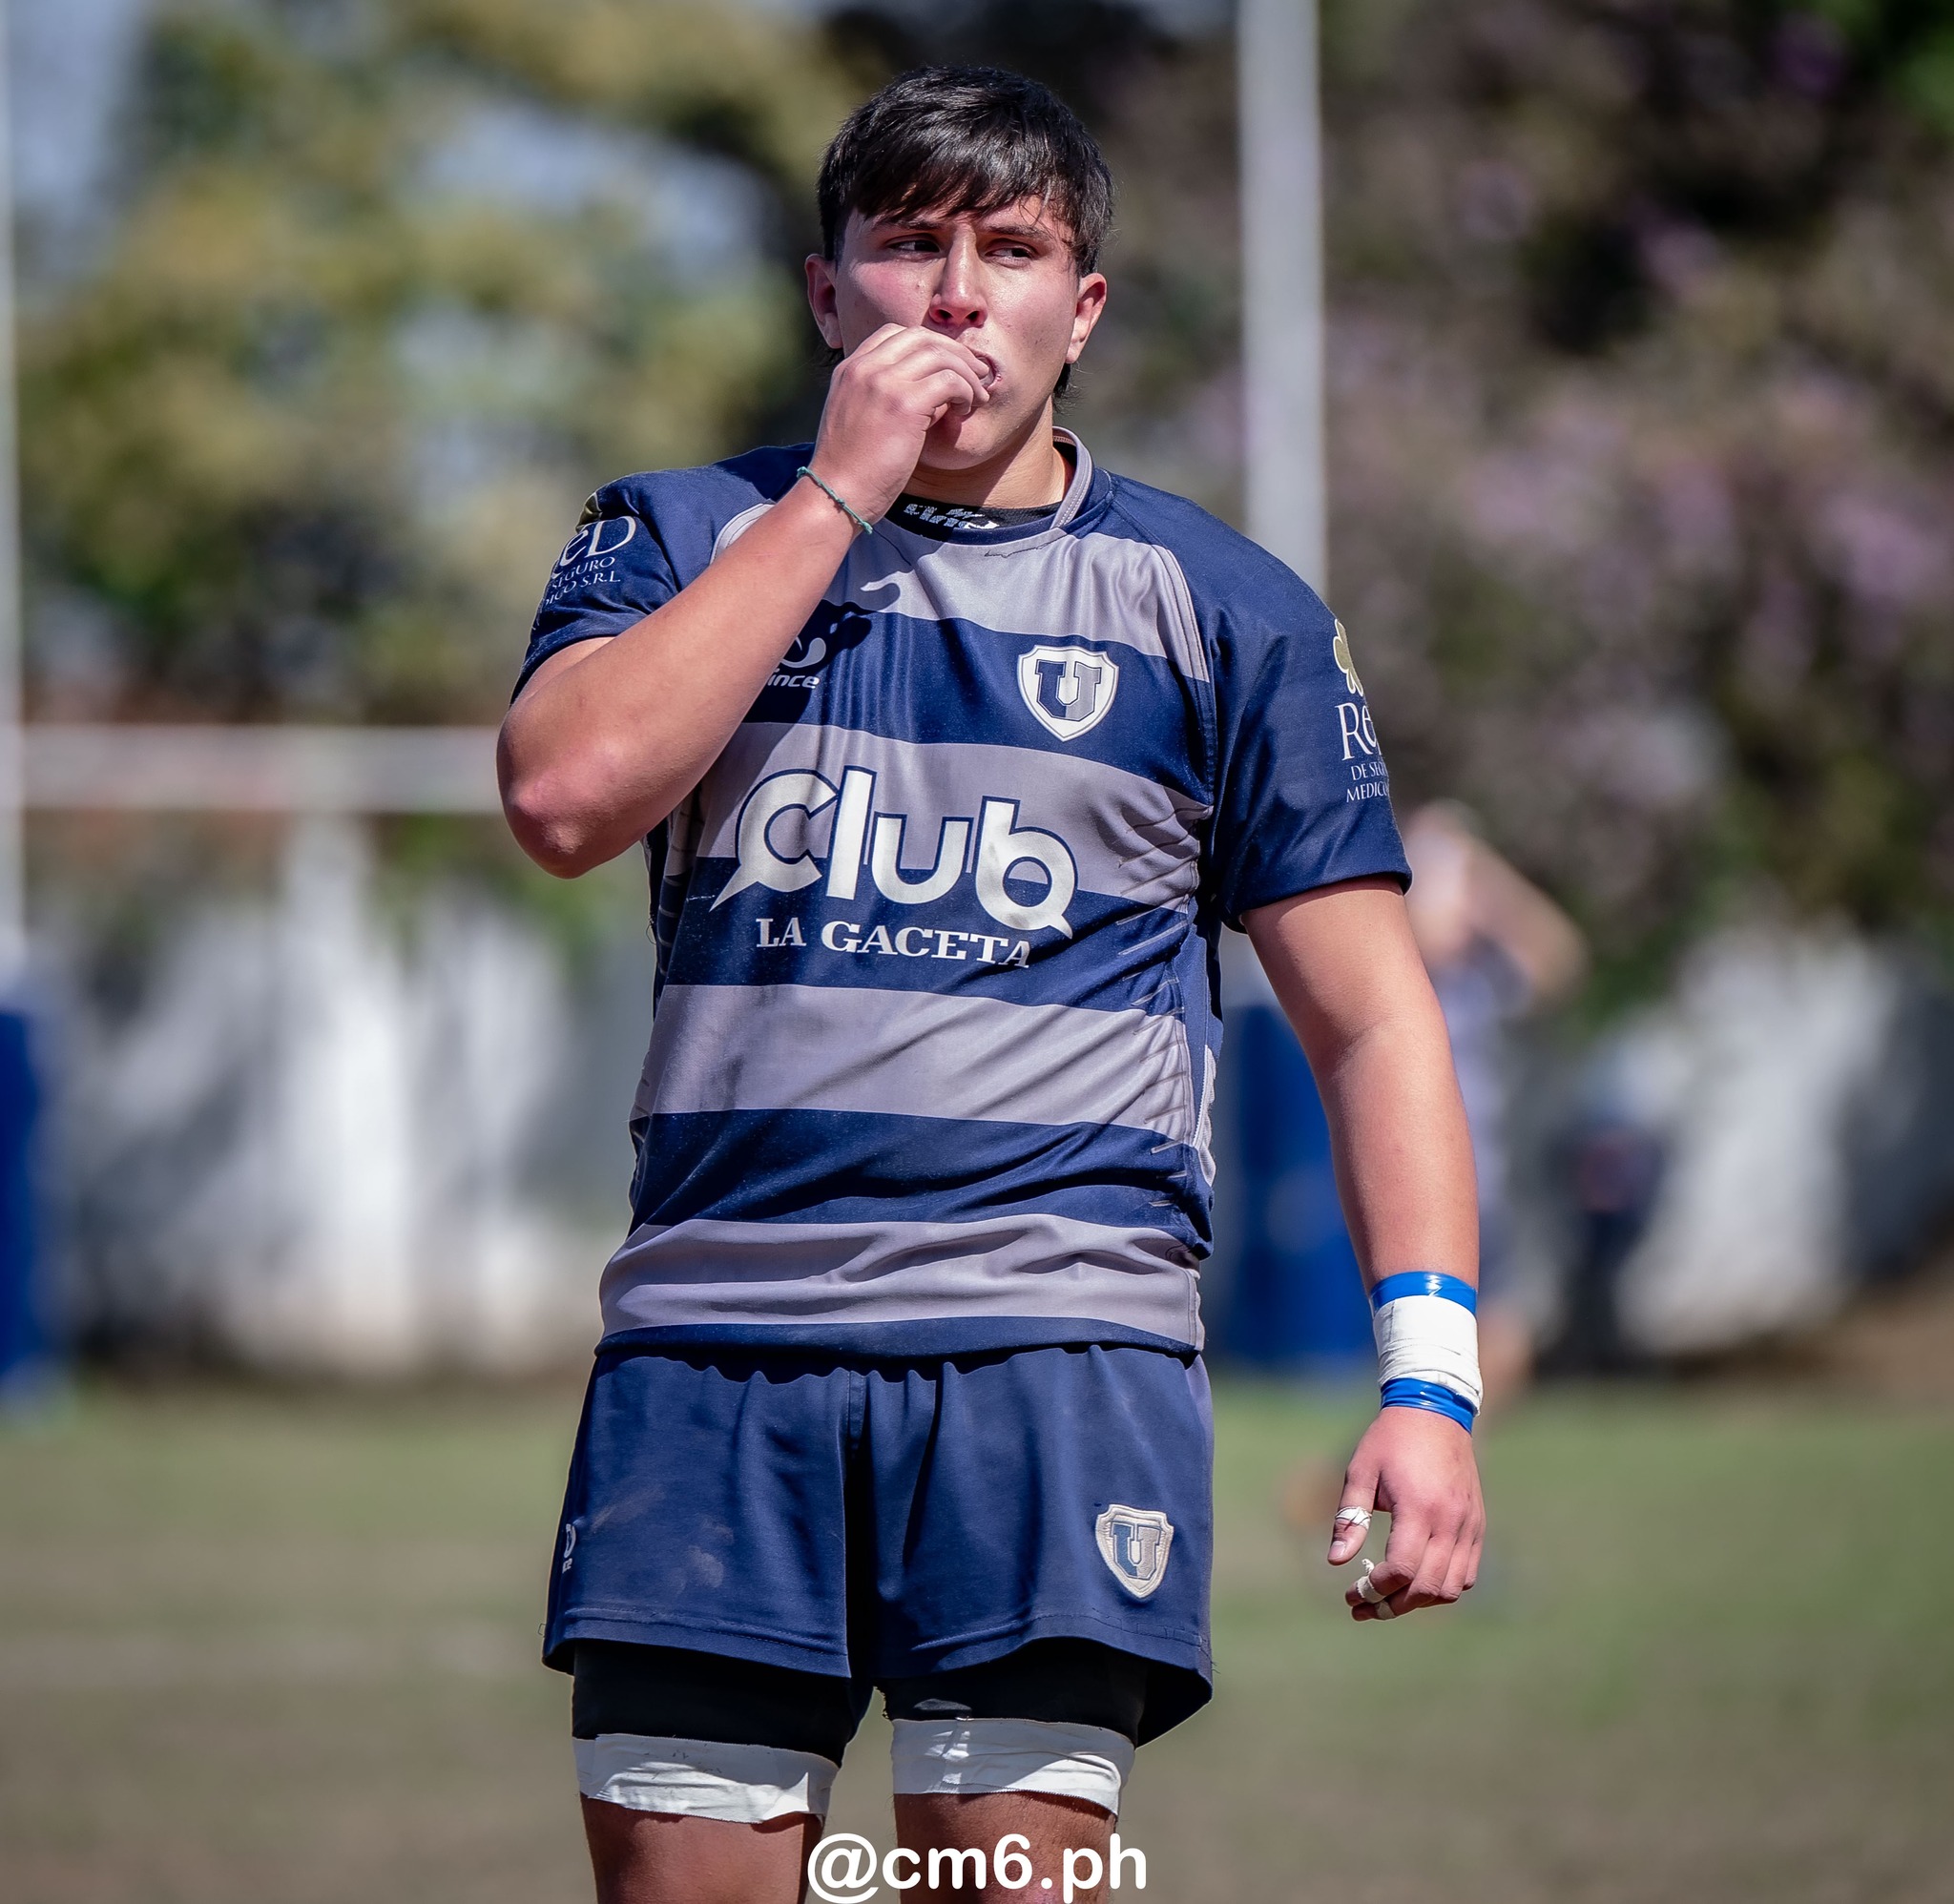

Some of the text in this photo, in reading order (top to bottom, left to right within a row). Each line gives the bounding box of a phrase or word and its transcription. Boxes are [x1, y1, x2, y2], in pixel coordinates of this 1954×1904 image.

[1035, 658, 1102, 722] U
[1336, 702, 1382, 760] Re
[1351, 763, 1368, 781] DE
[756, 917, 1030, 969] LA GACETA
[1110, 1521, 1161, 1581] U
